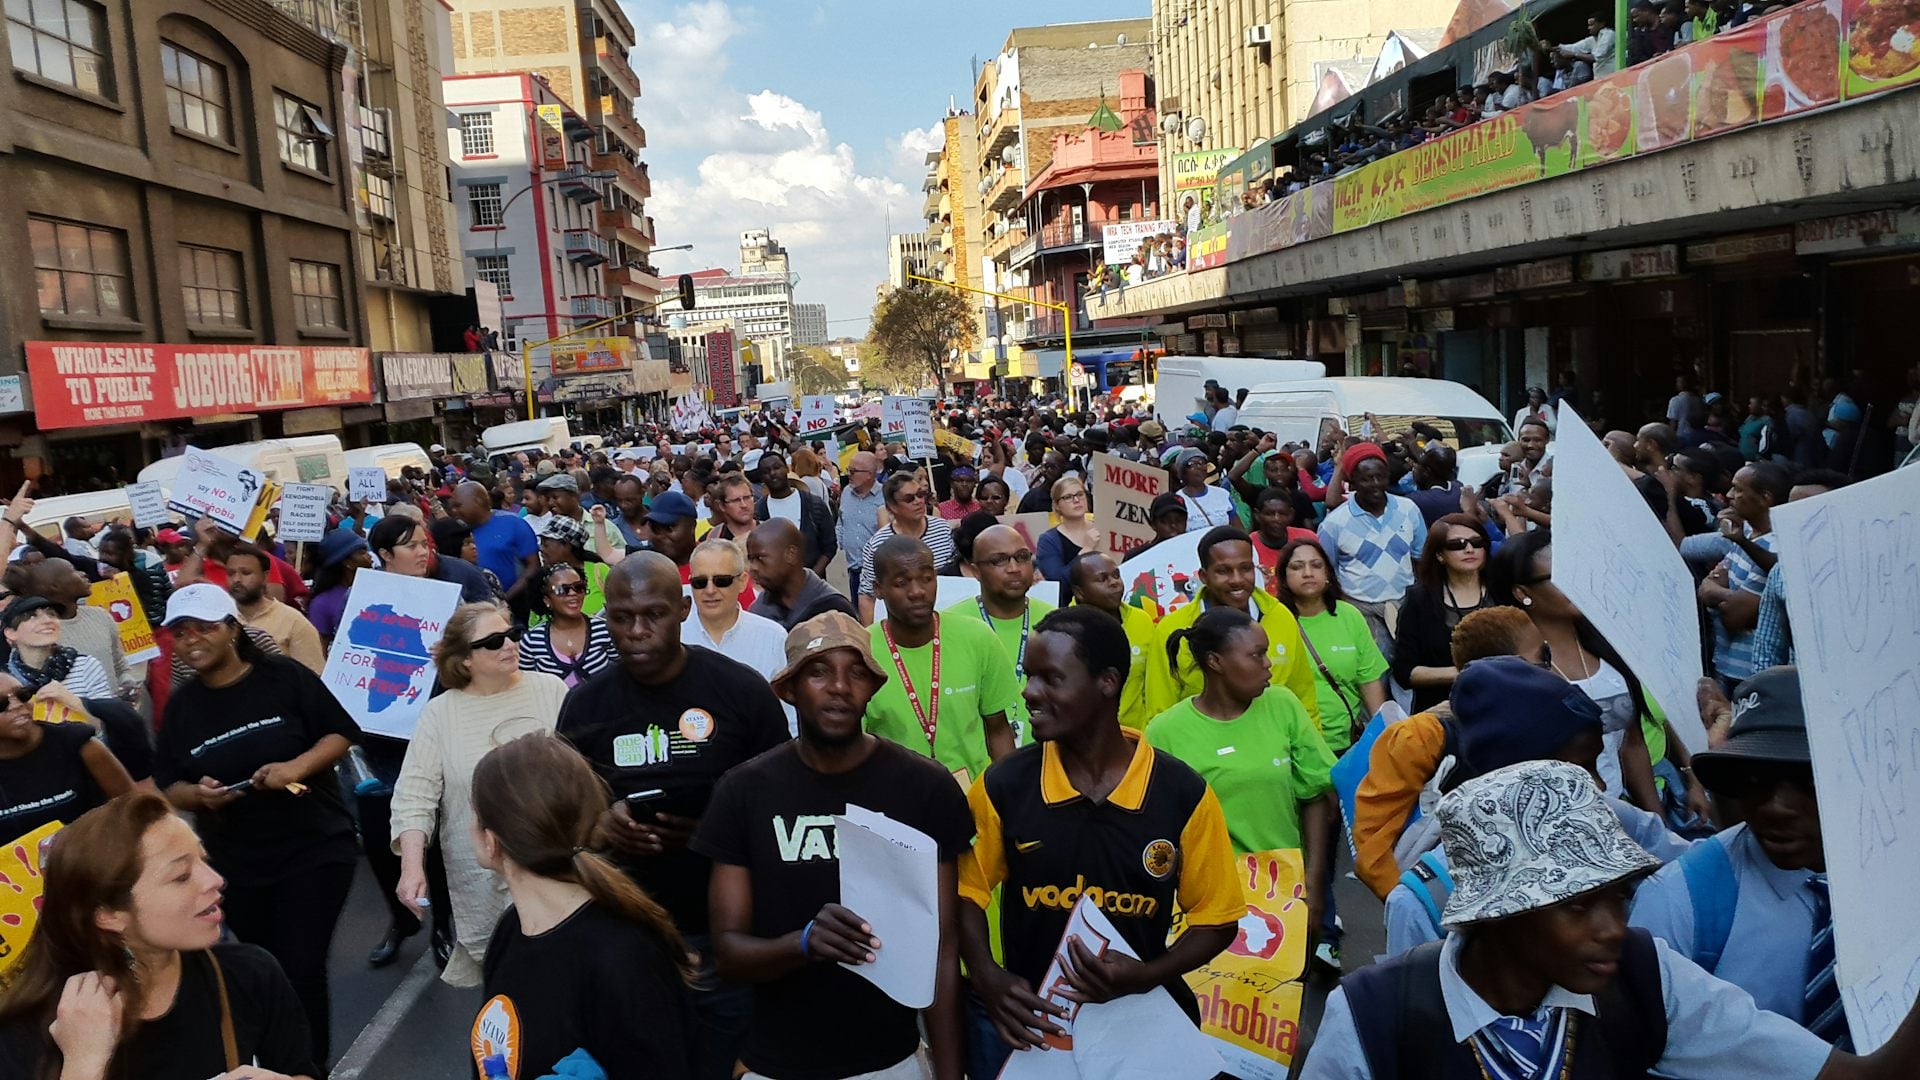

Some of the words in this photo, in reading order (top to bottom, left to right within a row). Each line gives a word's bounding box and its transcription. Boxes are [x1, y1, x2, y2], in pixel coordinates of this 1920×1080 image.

[51, 347, 156, 374] WHOLESALE
[720, 335, 733, 401] JOHANNESBURG
[65, 378, 92, 405] TO
[94, 376, 153, 403] PUBLIC
[174, 353, 251, 409] JOBURG
[197, 484, 210, 494] say
[211, 487, 227, 499] NO
[358, 480, 375, 488] ALL
[1105, 464, 1159, 496] MORE
[186, 494, 236, 521] Xenophobia
[359, 609, 380, 622] NO
[381, 614, 440, 632] AFRICAN
[342, 652, 425, 678] FOREIGNER
[335, 671, 352, 686] IN
[355, 676, 417, 700] AFRICA
[259, 716, 281, 725] World
[616, 736, 642, 747] one
[1022, 874, 1157, 915] vodacom
